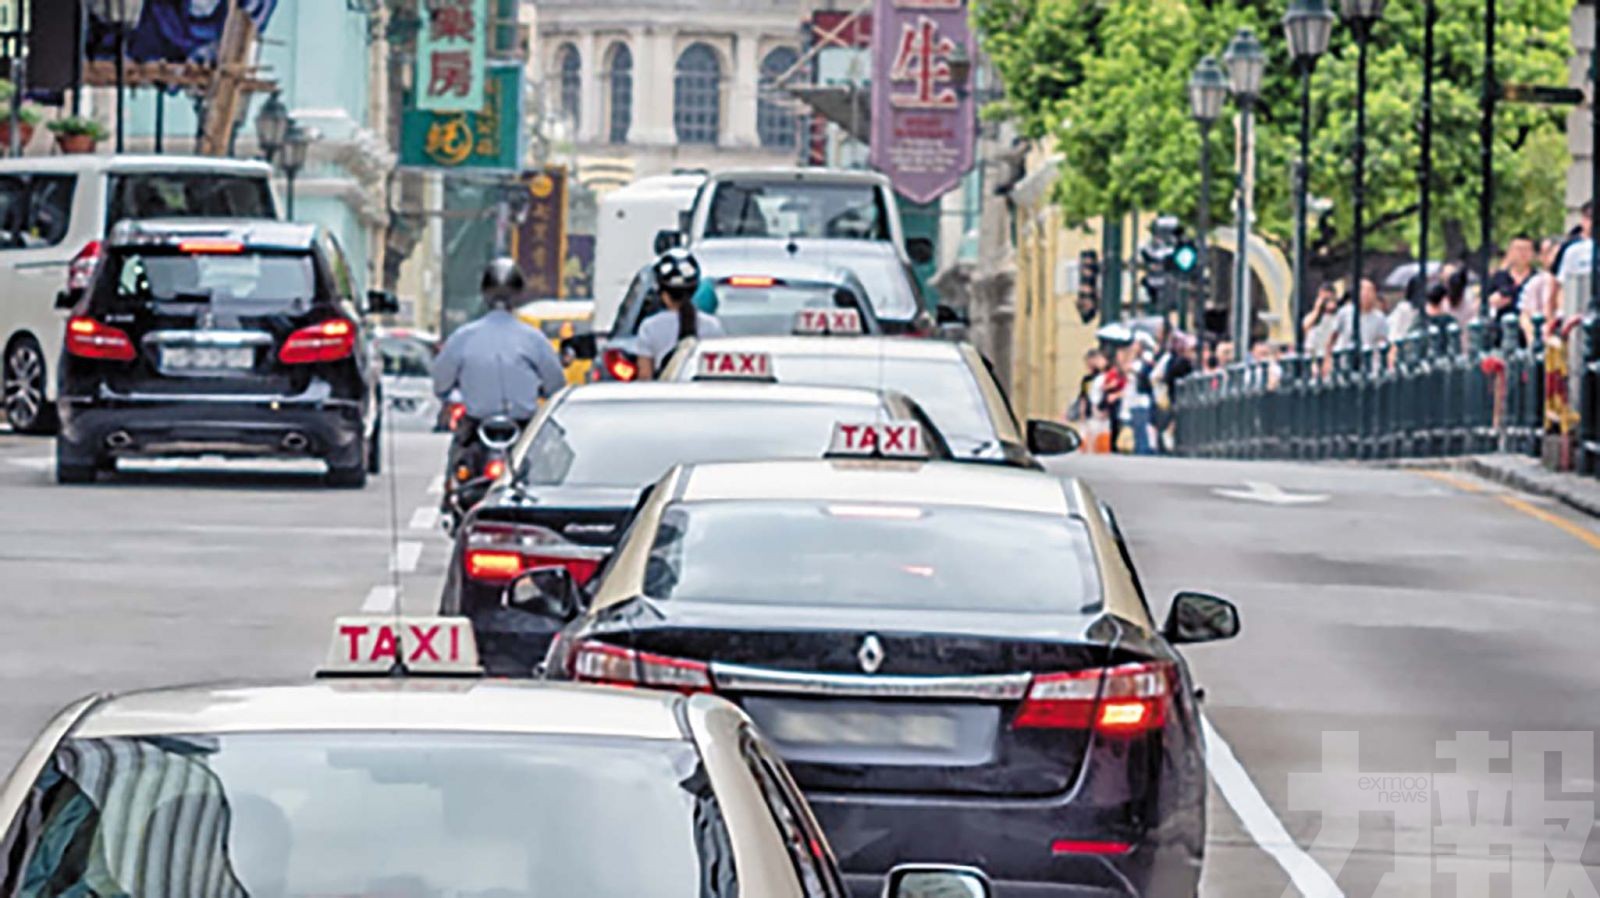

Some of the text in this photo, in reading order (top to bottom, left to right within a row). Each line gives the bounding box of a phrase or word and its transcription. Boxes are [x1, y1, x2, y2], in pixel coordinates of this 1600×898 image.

[890, 0, 962, 108] 生
[801, 312, 858, 331] TAXI
[702, 352, 767, 374] TAXI
[840, 425, 918, 451] TAXI
[339, 625, 460, 662] TAXI
